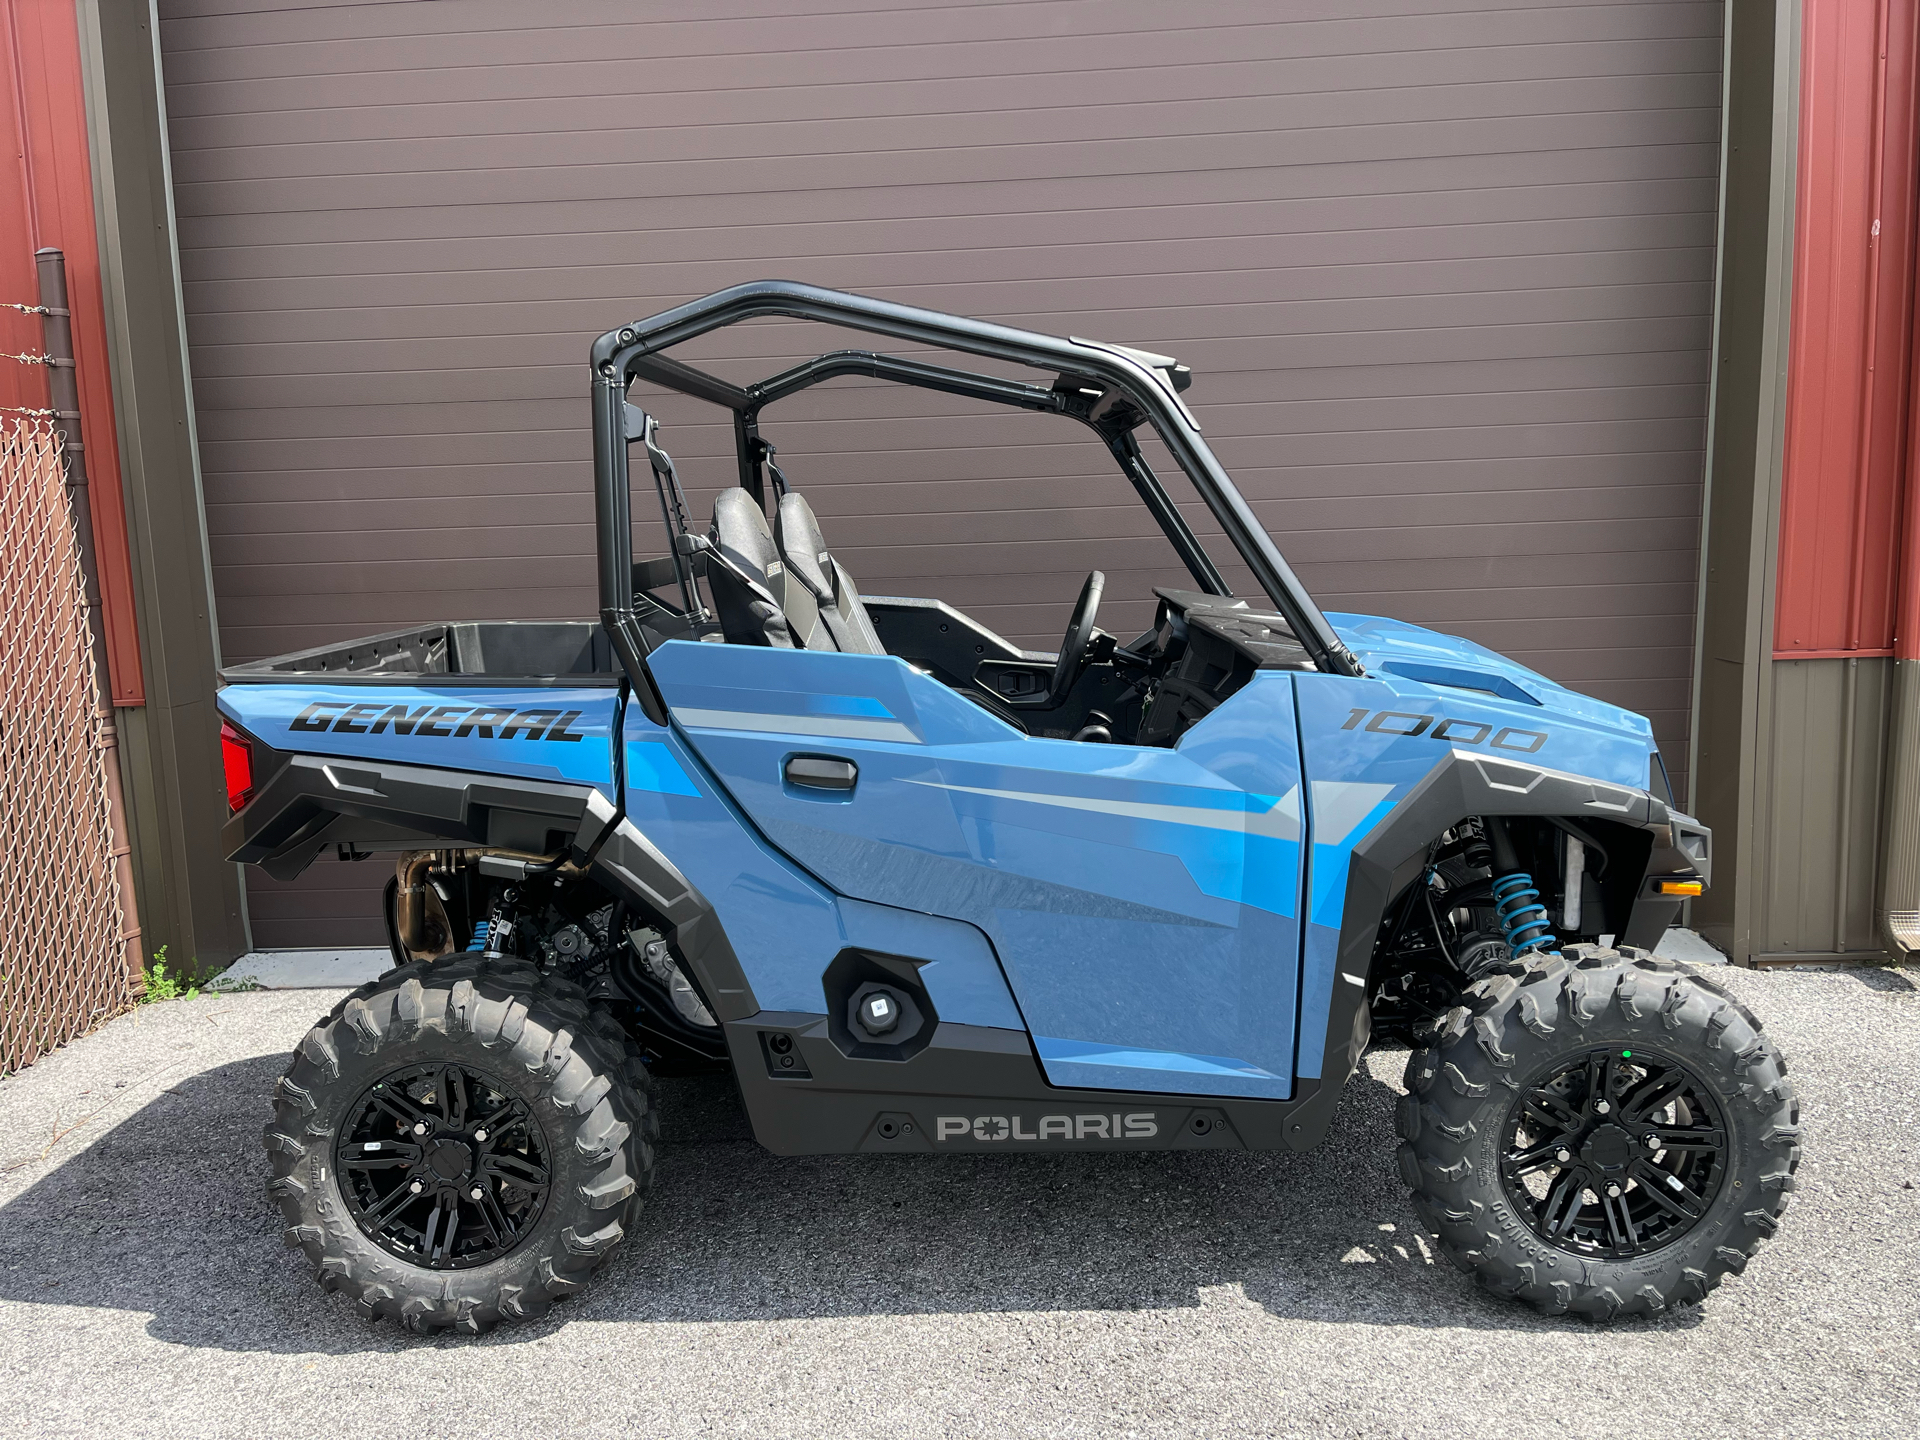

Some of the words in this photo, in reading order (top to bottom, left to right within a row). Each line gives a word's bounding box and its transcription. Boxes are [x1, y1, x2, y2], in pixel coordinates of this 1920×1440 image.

[288, 701, 584, 743] GENERAL
[1340, 708, 1549, 754] 1000
[485, 907, 502, 949] FOX
[936, 1112, 1158, 1141] POLARIS
